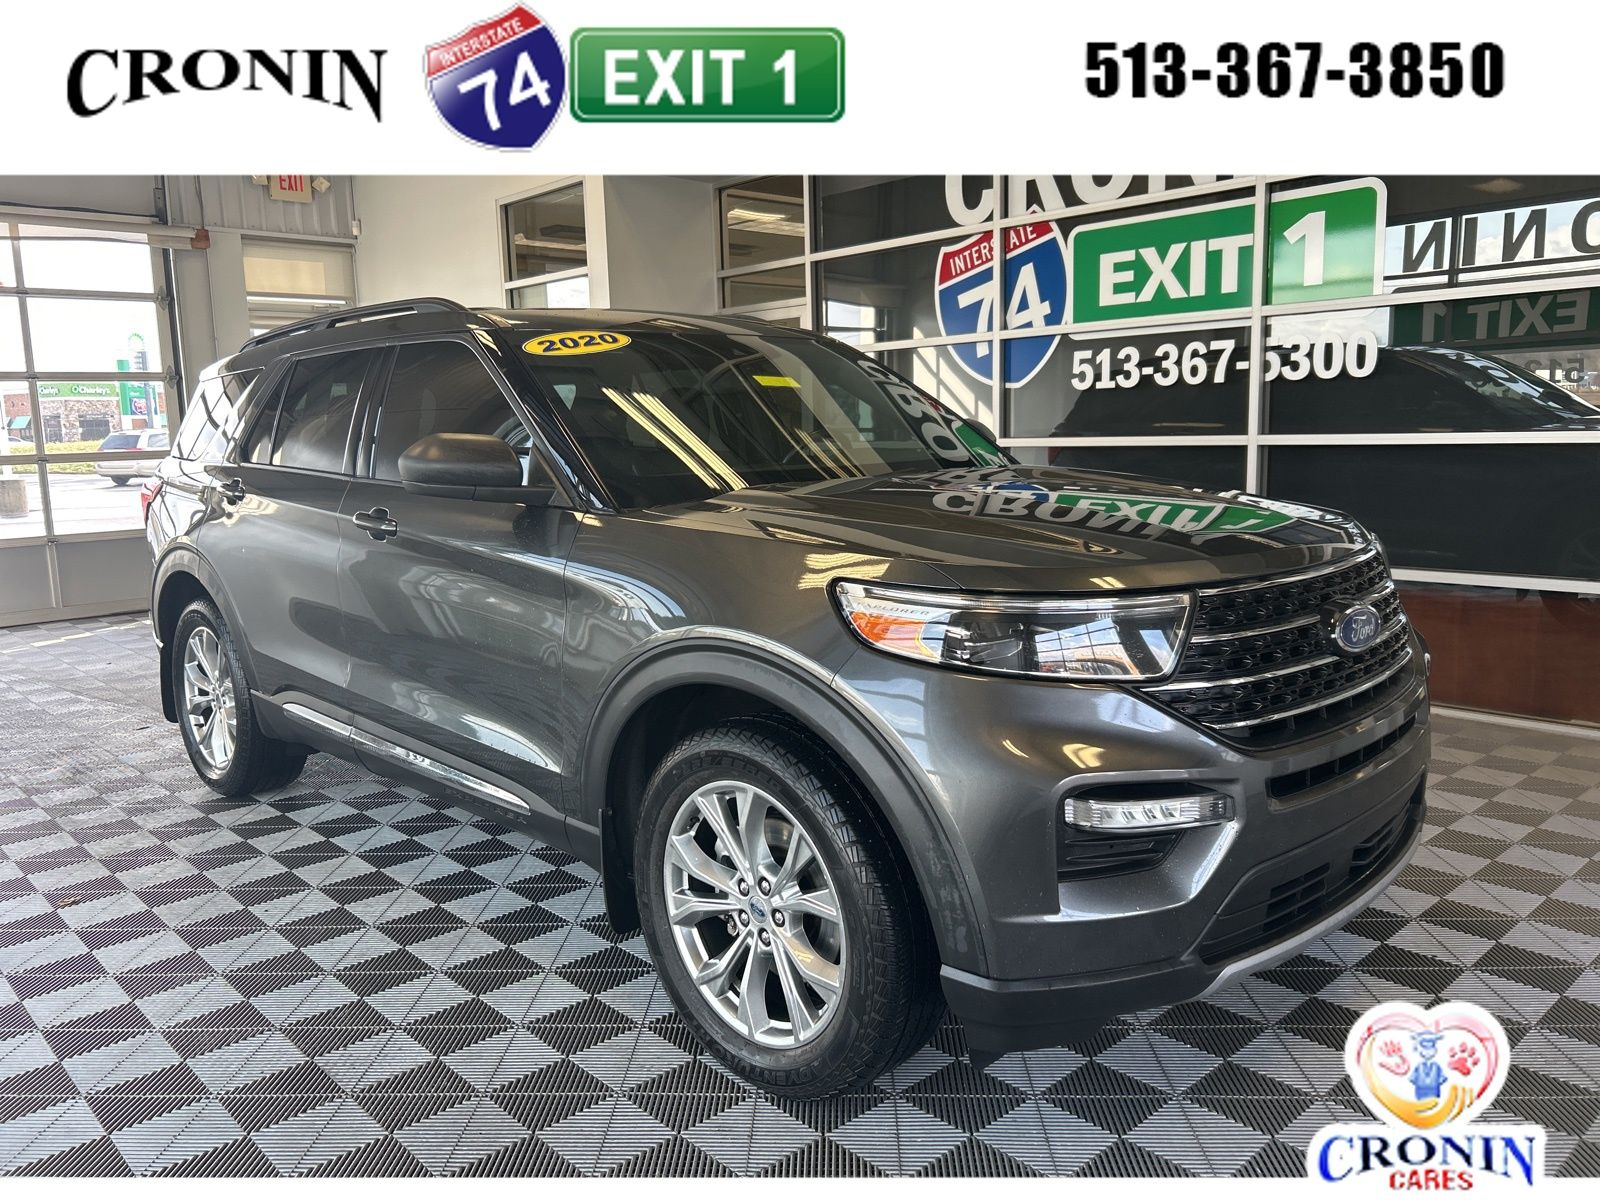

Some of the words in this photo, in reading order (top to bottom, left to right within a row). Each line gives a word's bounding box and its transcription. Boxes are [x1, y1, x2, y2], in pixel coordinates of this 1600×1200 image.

[1099, 233, 1254, 307] EXIT
[1284, 211, 1326, 287] 1
[957, 262, 1051, 358] 74
[537, 333, 618, 353] 2020
[1351, 614, 1376, 643] Ford
